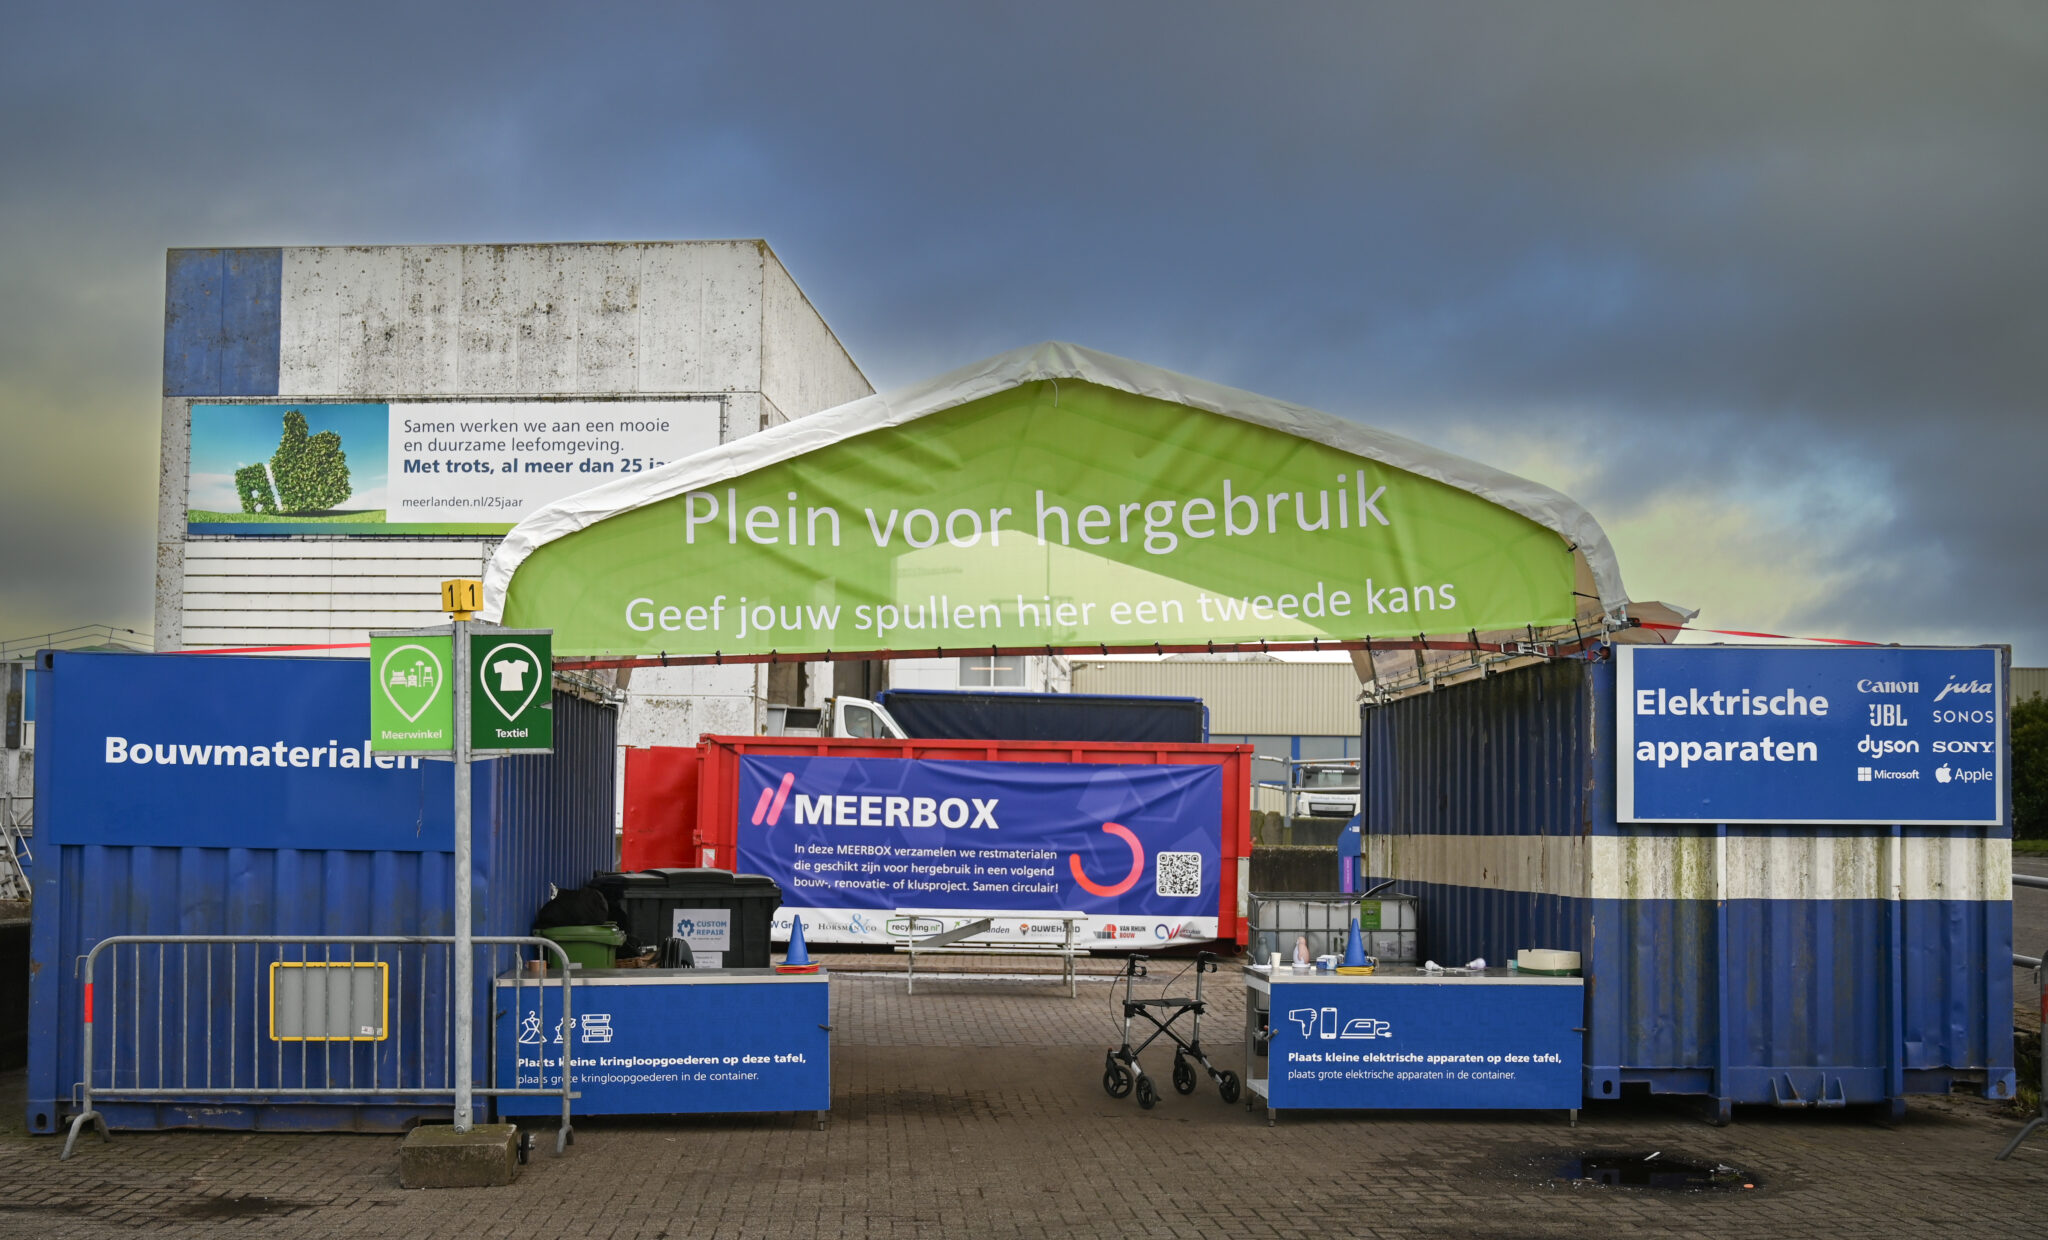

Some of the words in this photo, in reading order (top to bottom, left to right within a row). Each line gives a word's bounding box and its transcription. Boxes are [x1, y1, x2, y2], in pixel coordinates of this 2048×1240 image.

[404, 419, 455, 433] Samen
[461, 418, 517, 433] werken
[523, 421, 545, 433] we
[552, 421, 579, 433] aan
[586, 421, 614, 433] een
[620, 418, 670, 433] mooie
[404, 441, 422, 452] en
[428, 437, 506, 452] duurzame
[511, 436, 624, 455] leefomgeving.
[403, 459, 439, 473] Met
[446, 459, 495, 475] trots,
[502, 457, 518, 473] al
[525, 461, 576, 473] meer
[580, 458, 614, 472] dan
[620, 458, 642, 472] 25
[402, 495, 523, 509] meerlanden.nl/25jaar
[685, 488, 840, 546] Plein
[865, 507, 1012, 548] voor
[1035, 470, 1390, 555] hergebruik
[448, 584, 454, 607] 1
[468, 583, 476, 607] 1
[625, 595, 727, 632] Geef
[735, 597, 841, 639] jouw
[855, 595, 1001, 638] spullen
[1017, 594, 1096, 628] hier
[1110, 601, 1184, 625] een
[1196, 582, 1352, 623] tweede
[1366, 578, 1457, 614] kans
[1856, 678, 1919, 694] Canon
[1933, 675, 1992, 702] jura
[1636, 688, 1829, 716] Elektrische
[1933, 709, 1994, 723] SONOS
[381, 729, 442, 740] Meerwinkel
[496, 727, 528, 738] Textiel
[1636, 736, 1818, 768] apparaten
[1857, 734, 1919, 759] dyson
[1932, 740, 1994, 753] SONY
[1874, 767, 1920, 781] Microsoft
[1954, 767, 1993, 783] Apple
[794, 794, 1000, 829] MEERBOX
[794, 843, 805, 853] In
[809, 843, 833, 855] deze
[836, 844, 892, 856] MEERBOX
[894, 846, 957, 858] verzamelen
[960, 850, 976, 859] we
[979, 848, 1058, 860] restmaterialen
[794, 860, 810, 872] die
[813, 860, 858, 875] geschikt
[861, 861, 882, 876] zijn
[884, 865, 908, 874] voor
[911, 863, 970, 877] hergebruik
[974, 865, 984, 875] in
[988, 867, 1008, 875] een
[1012, 865, 1055, 878] volgend
[794, 877, 832, 889] bouw-,
[835, 878, 890, 890] renovatie-
[893, 879, 905, 890] of
[907, 879, 970, 894] klusproject.
[973, 882, 1007, 892] Samen
[1011, 881, 1060, 894] circulair!
[1031, 925, 1080, 933] OUWEHD
[558, 1056, 597, 1067] keine
[600, 1054, 719, 1069] kringloopgoederen
[722, 1056, 739, 1067] op
[742, 1054, 771, 1064] deze
[774, 1053, 806, 1065] tafel,
[1288, 1053, 1322, 1062] Plaats
[1325, 1053, 1360, 1062] kleine
[1363, 1053, 1424, 1063] elektrische
[1427, 1054, 1484, 1065] apparaten
[1487, 1055, 1502, 1065] op
[1505, 1053, 1530, 1063] deze
[1533, 1053, 1562, 1065] tafel,
[581, 1072, 678, 1084] kringloopgoederen
[681, 1072, 690, 1081] in
[693, 1071, 707, 1081] de
[710, 1071, 759, 1081] container.
[1288, 1070, 1316, 1081] plaats
[1318, 1071, 1343, 1081] grote
[1346, 1070, 1394, 1079] elektrische
[1397, 1072, 1444, 1081] apparaten
[1446, 1071, 1455, 1079] in
[1458, 1070, 1469, 1079] de
[1472, 1071, 1516, 1080] container.
